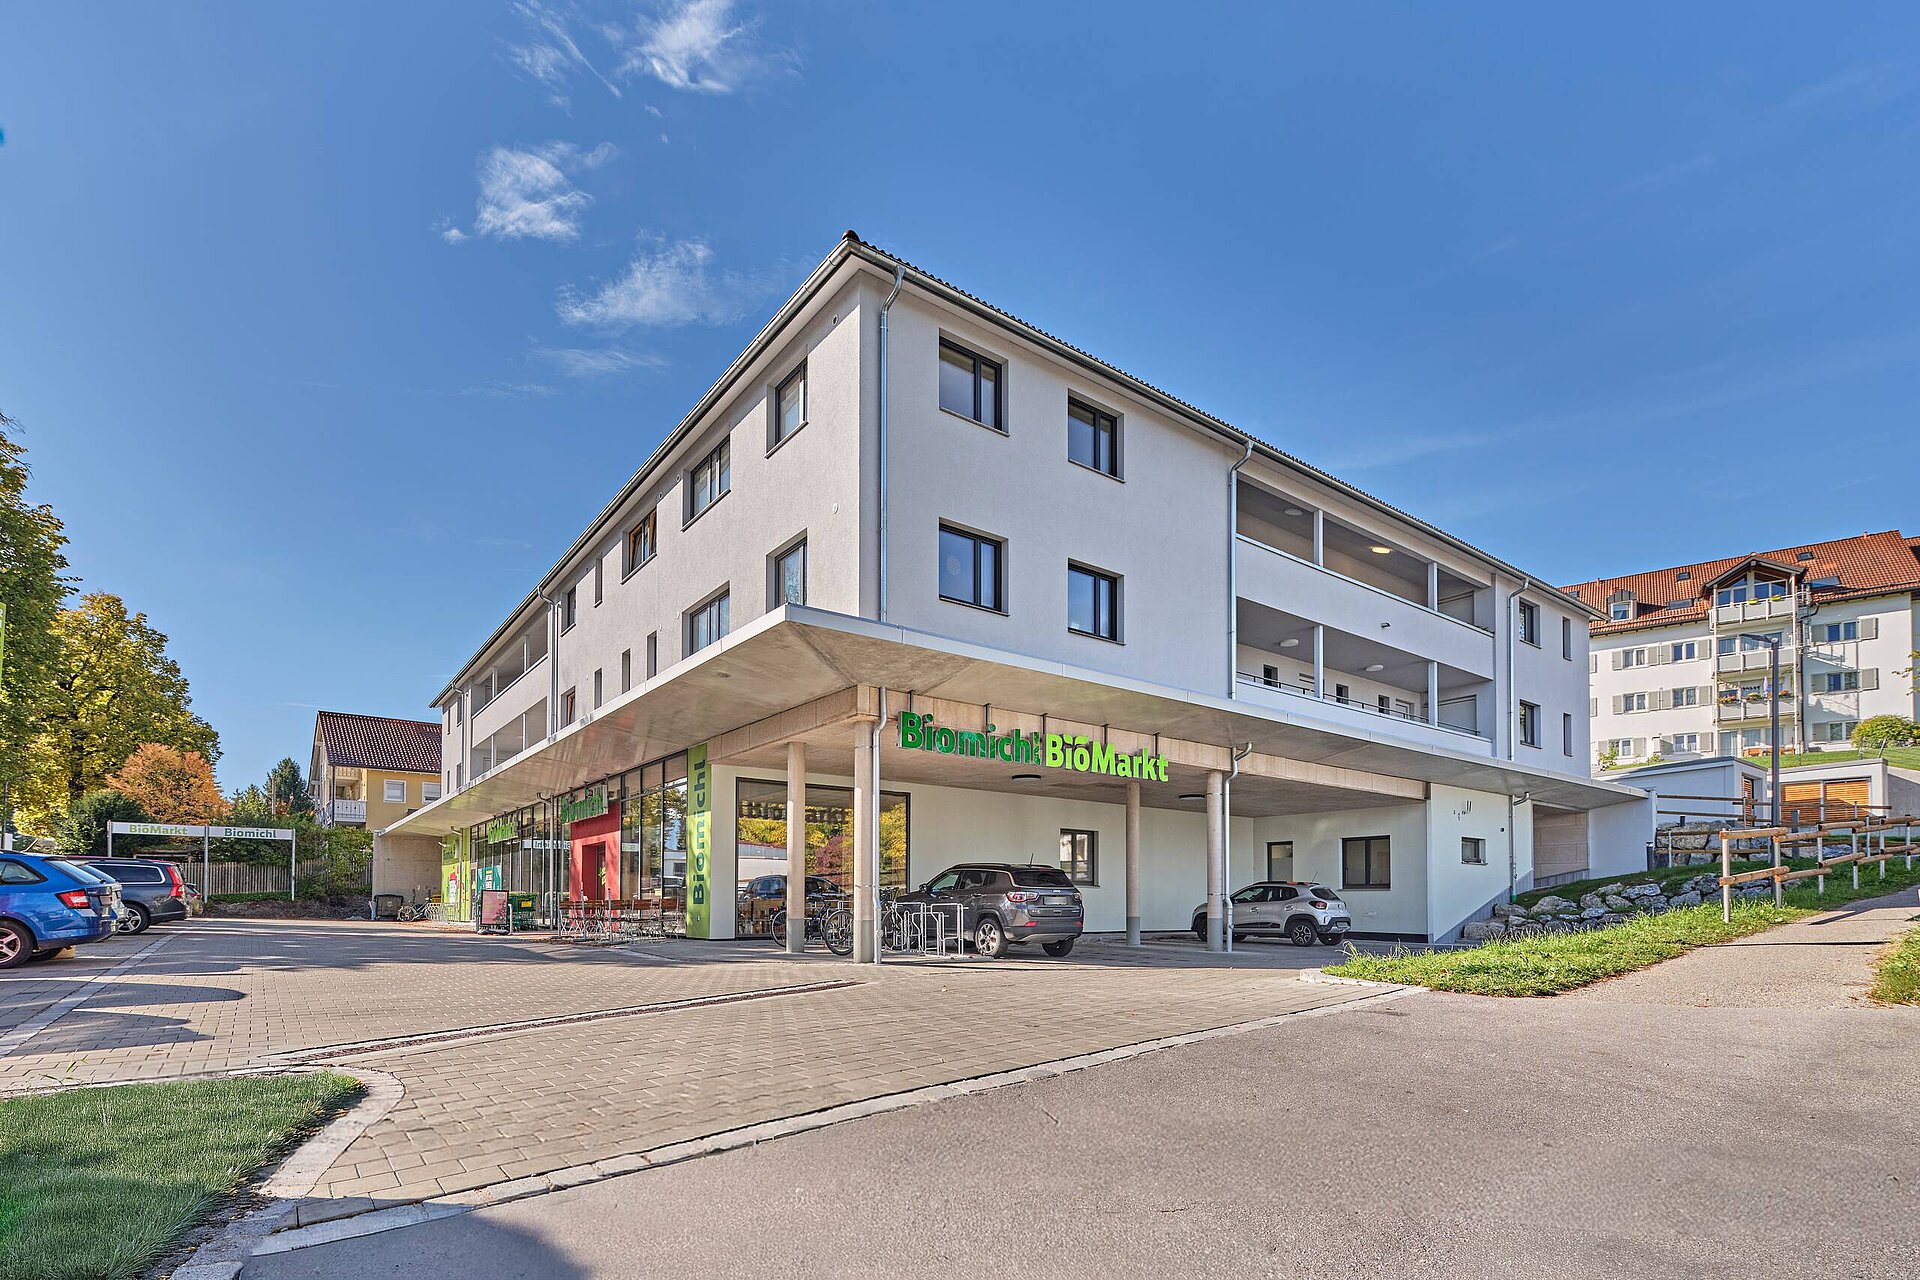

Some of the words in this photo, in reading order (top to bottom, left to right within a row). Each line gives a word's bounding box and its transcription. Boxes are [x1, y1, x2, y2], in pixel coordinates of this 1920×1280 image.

[899, 710, 1042, 767] Biomichl
[224, 827, 277, 839] Biomichl
[692, 758, 707, 905] Biomichl
